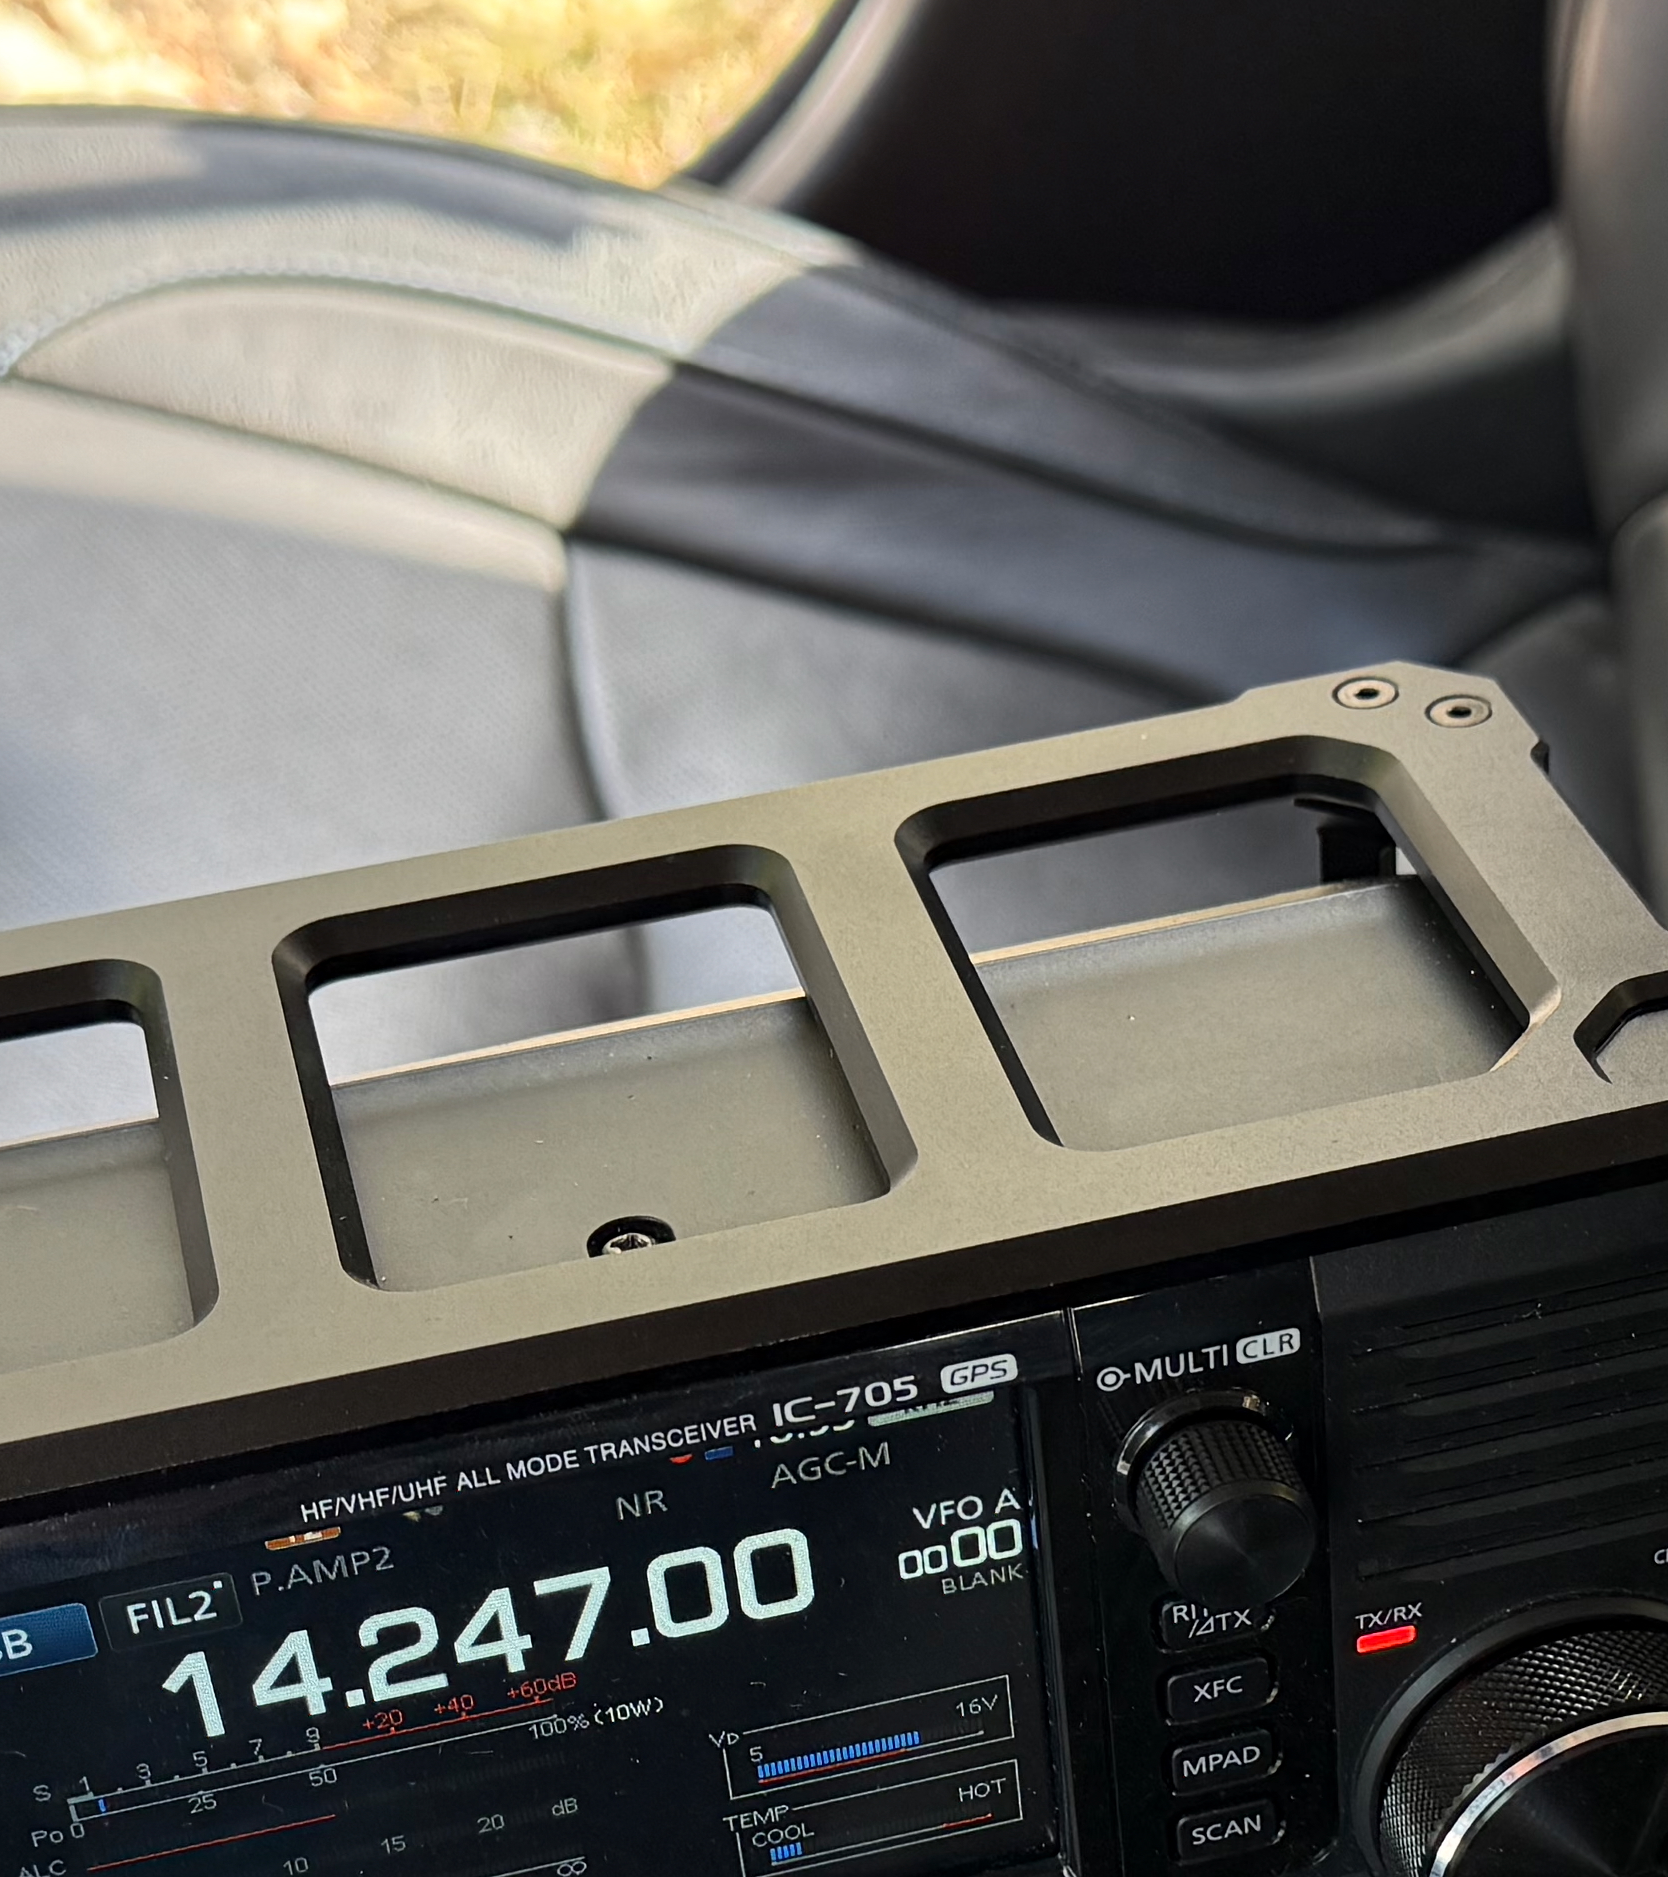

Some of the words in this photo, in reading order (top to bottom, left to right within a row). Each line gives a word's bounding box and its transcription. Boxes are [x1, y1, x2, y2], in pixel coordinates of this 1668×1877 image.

[1133, 1347, 1229, 1385] MULTI
[1242, 1332, 1297, 1362] CLR
[300, 1475, 448, 1523] HF/VHF/UHF
[457, 1466, 501, 1492] ALL
[506, 1450, 580, 1481] MODE
[585, 1414, 757, 1461] TRANSCEIVER
[773, 1375, 919, 1427] IC-705
[947, 1357, 1010, 1388] GPS
[770, 1441, 892, 1489] AGC-M
[912, 1495, 984, 1530] VFO
[994, 1487, 1023, 1515] A
[251, 1546, 395, 1596] P.AMP2
[616, 1490, 669, 1519] NR
[941, 1563, 1025, 1595] BLANK
[128, 1591, 217, 1636] FIL2
[161, 1527, 816, 1738] 14.247.00
[1355, 1602, 1423, 1631] TX/RX
[1192, 1675, 1245, 1703] XFC
[33, 1784, 52, 1802] S
[136, 1763, 152, 1782] 3
[193, 1750, 209, 1768] 5
[248, 1738, 264, 1756] 7
[362, 1708, 405, 1732] +20
[433, 1693, 475, 1716] +40
[507, 1671, 578, 1699] +60dB
[748, 1745, 764, 1764] 5
[955, 1693, 1001, 1719] 16V
[188, 1793, 218, 1815] 25
[308, 1767, 340, 1789] 50
[528, 1712, 591, 1740] 100%
[593, 1697, 665, 1726] (10W)
[1181, 1745, 1262, 1779] MPAD
[282, 1856, 310, 1877] 10
[379, 1835, 407, 1855] 15
[476, 1813, 506, 1834] 20
[550, 1796, 580, 1817] dB
[722, 1803, 791, 1834] TEMP
[750, 1821, 817, 1849] COOL
[958, 1776, 1009, 1804] HOT
[1190, 1814, 1263, 1846] SCAN
